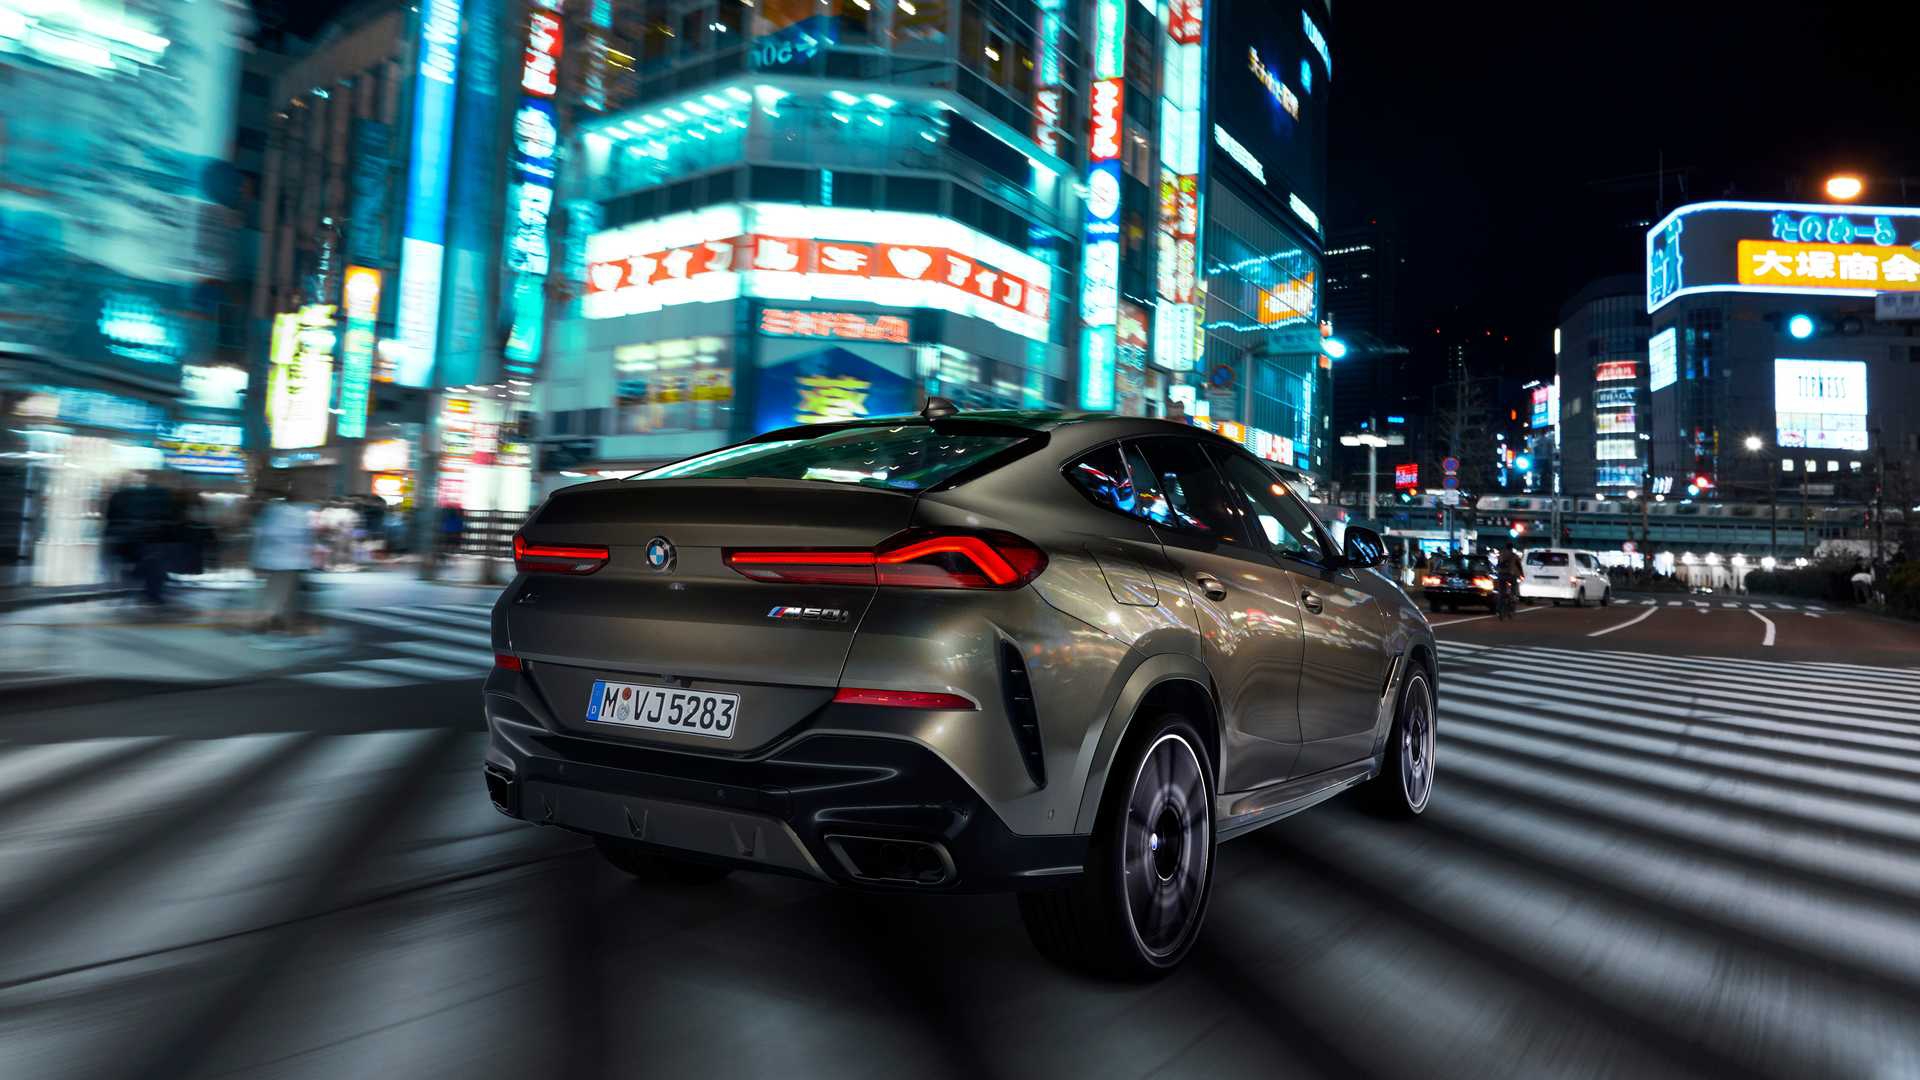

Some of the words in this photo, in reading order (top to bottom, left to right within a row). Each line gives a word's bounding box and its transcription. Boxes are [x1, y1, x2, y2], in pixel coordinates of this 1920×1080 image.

[1772, 211, 1896, 246] たのめーる
[1753, 250, 1920, 282] 大塚商会
[601, 687, 620, 718] M
[634, 690, 665, 722] VJ
[668, 695, 735, 731] 5283
